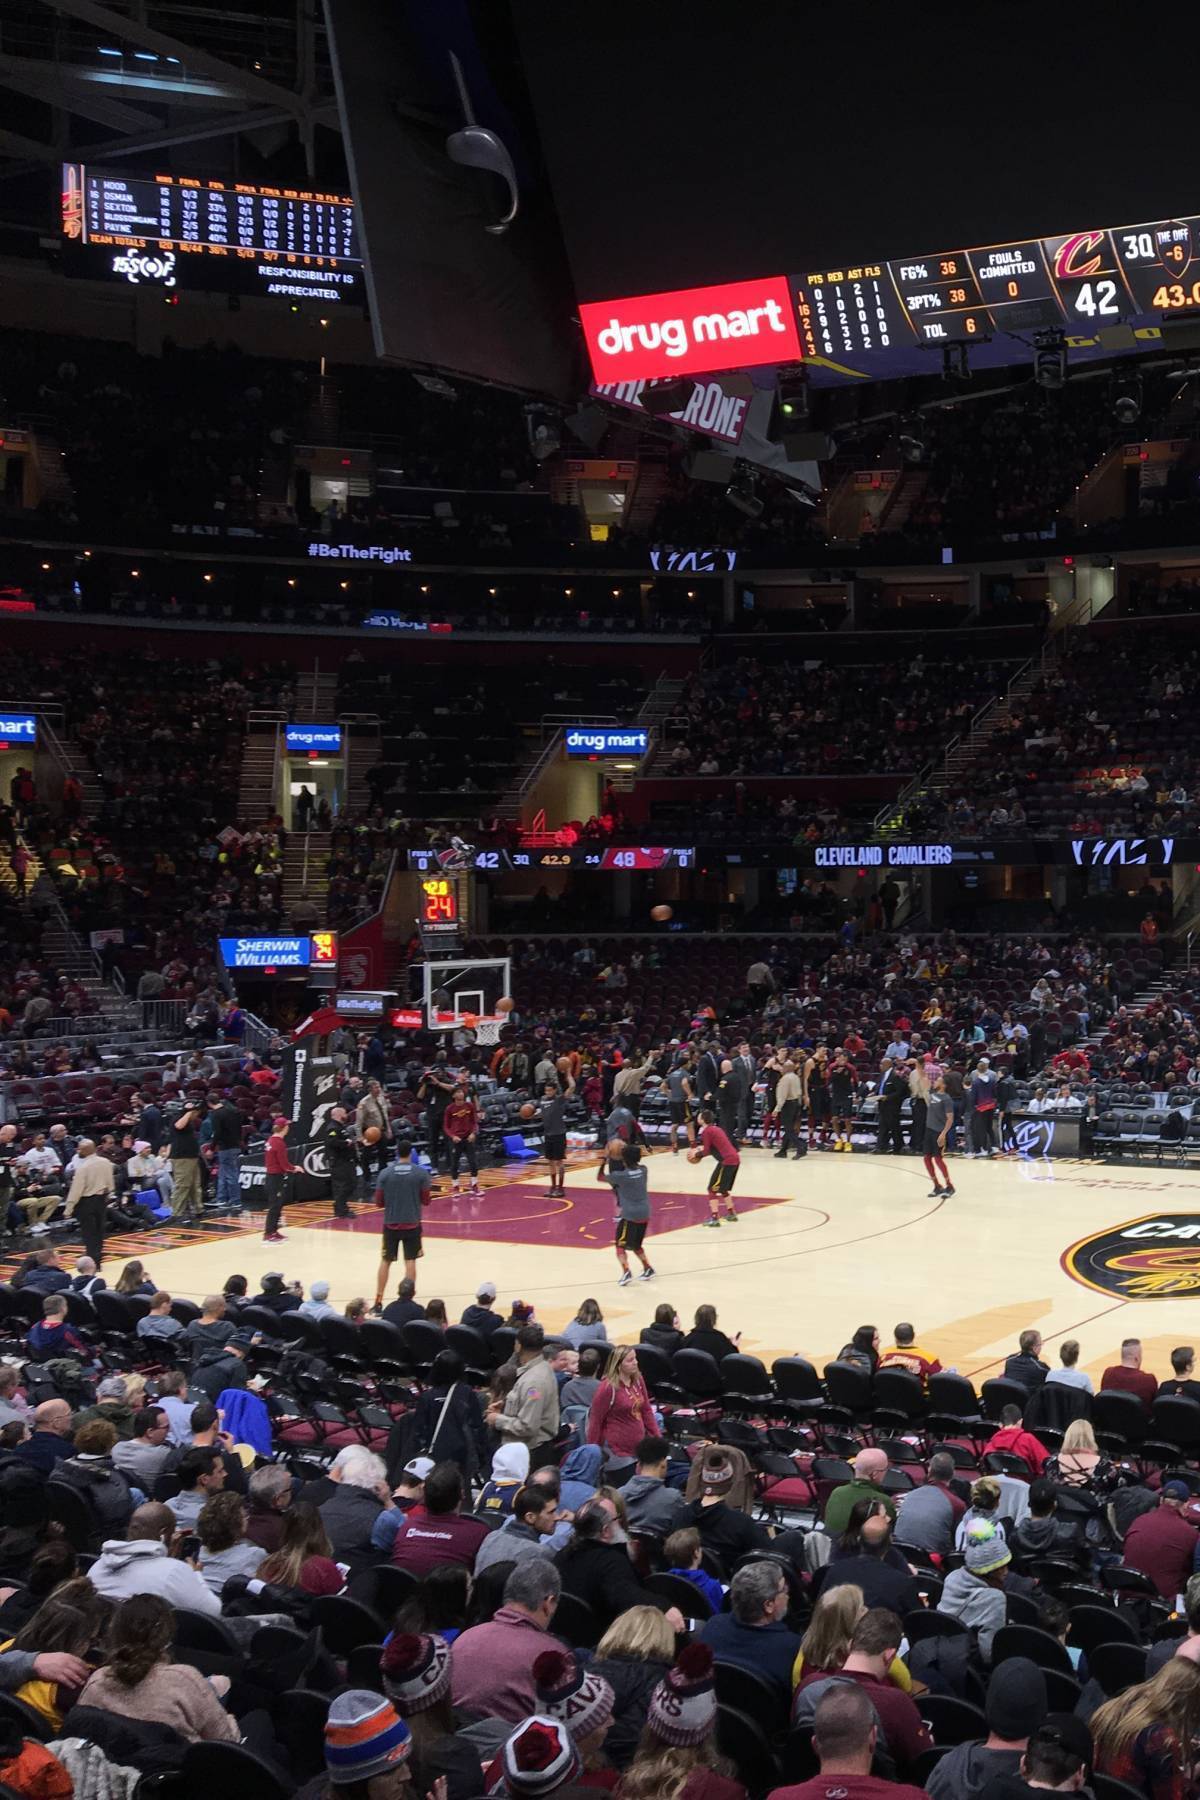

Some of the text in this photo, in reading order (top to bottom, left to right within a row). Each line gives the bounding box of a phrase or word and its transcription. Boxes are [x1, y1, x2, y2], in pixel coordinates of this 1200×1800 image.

[104, 181, 198, 199] HOOD 0/3
[104, 192, 134, 202] OSMAN
[104, 202, 137, 213] SEXTON
[104, 223, 198, 240] PAYNE 2/5
[182, 220, 198, 230] 2/5
[90, 234, 146, 247] TEAM TOTALS
[1157, 228, 1189, 244] THE DIFF
[1123, 234, 1155, 259] 3Q
[1166, 245, 1183, 260] -6
[989, 251, 1022, 265] FOULS
[258, 266, 353, 283] RESPONSIBILITY IS
[808, 266, 880, 285] PTS REB AST FLS
[900, 261, 957, 281] FG% 36
[979, 260, 1036, 279] COMMITTED
[268, 284, 340, 299] APPRECIATED.
[814, 289, 822, 300] 0
[853, 284, 862, 294] 2
[1008, 281, 1018, 297] 0
[799, 305, 810, 315] 16
[817, 302, 825, 313] 2
[837, 300, 844, 310] 0
[856, 297, 864, 308] 0
[907, 288, 966, 311] 3PT% 38
[1075, 280, 1119, 317] 42
[803, 308, 884, 329] 2 9 2 0 0
[598, 299, 786, 357] drug mart
[806, 321, 887, 341] 4 4 3 0 0
[924, 318, 976, 339] TOL 6
[808, 335, 889, 355] 3 6 2 2 0
[308, 543, 411, 564] #BeTheFight
[287, 732, 340, 743] drug mart
[567, 732, 646, 750] drug mart
[418, 858, 427, 869] 0
[476, 852, 499, 868] 42
[541, 855, 570, 864] 42.9
[613, 852, 635, 866] 48
[679, 856, 687, 866] 0
[815, 847, 882, 866] CLEVELAND
[888, 846, 952, 864] CAVALIERS
[427, 897, 451, 919] 24
[237, 939, 300, 951] SHERWIN
[292, 1064, 304, 1122] Cleveland Clinic
